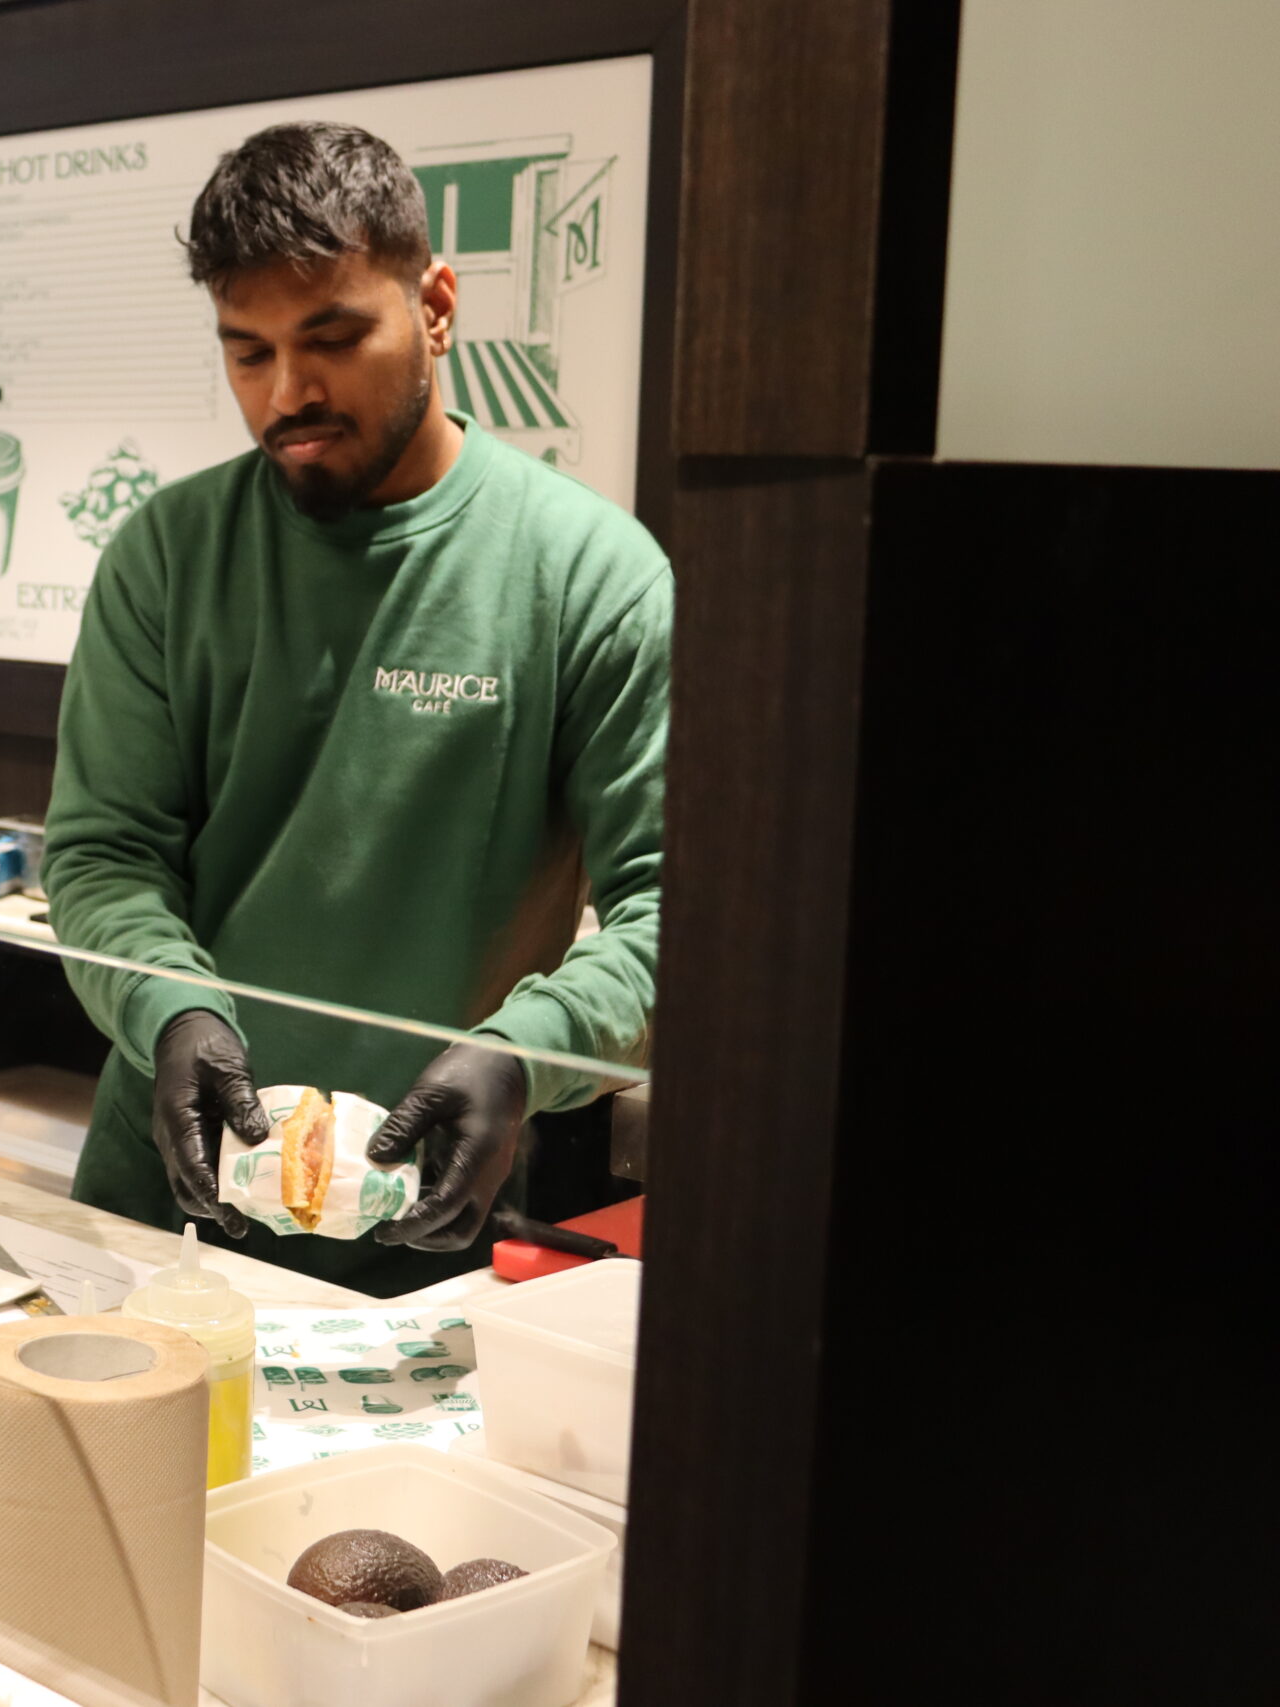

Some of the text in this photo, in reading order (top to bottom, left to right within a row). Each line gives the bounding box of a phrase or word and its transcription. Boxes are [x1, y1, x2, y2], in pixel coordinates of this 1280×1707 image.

[55, 141, 149, 179] DRINKS
[374, 666, 499, 702] MAURICE
[412, 699, 451, 714] CAFÉ
